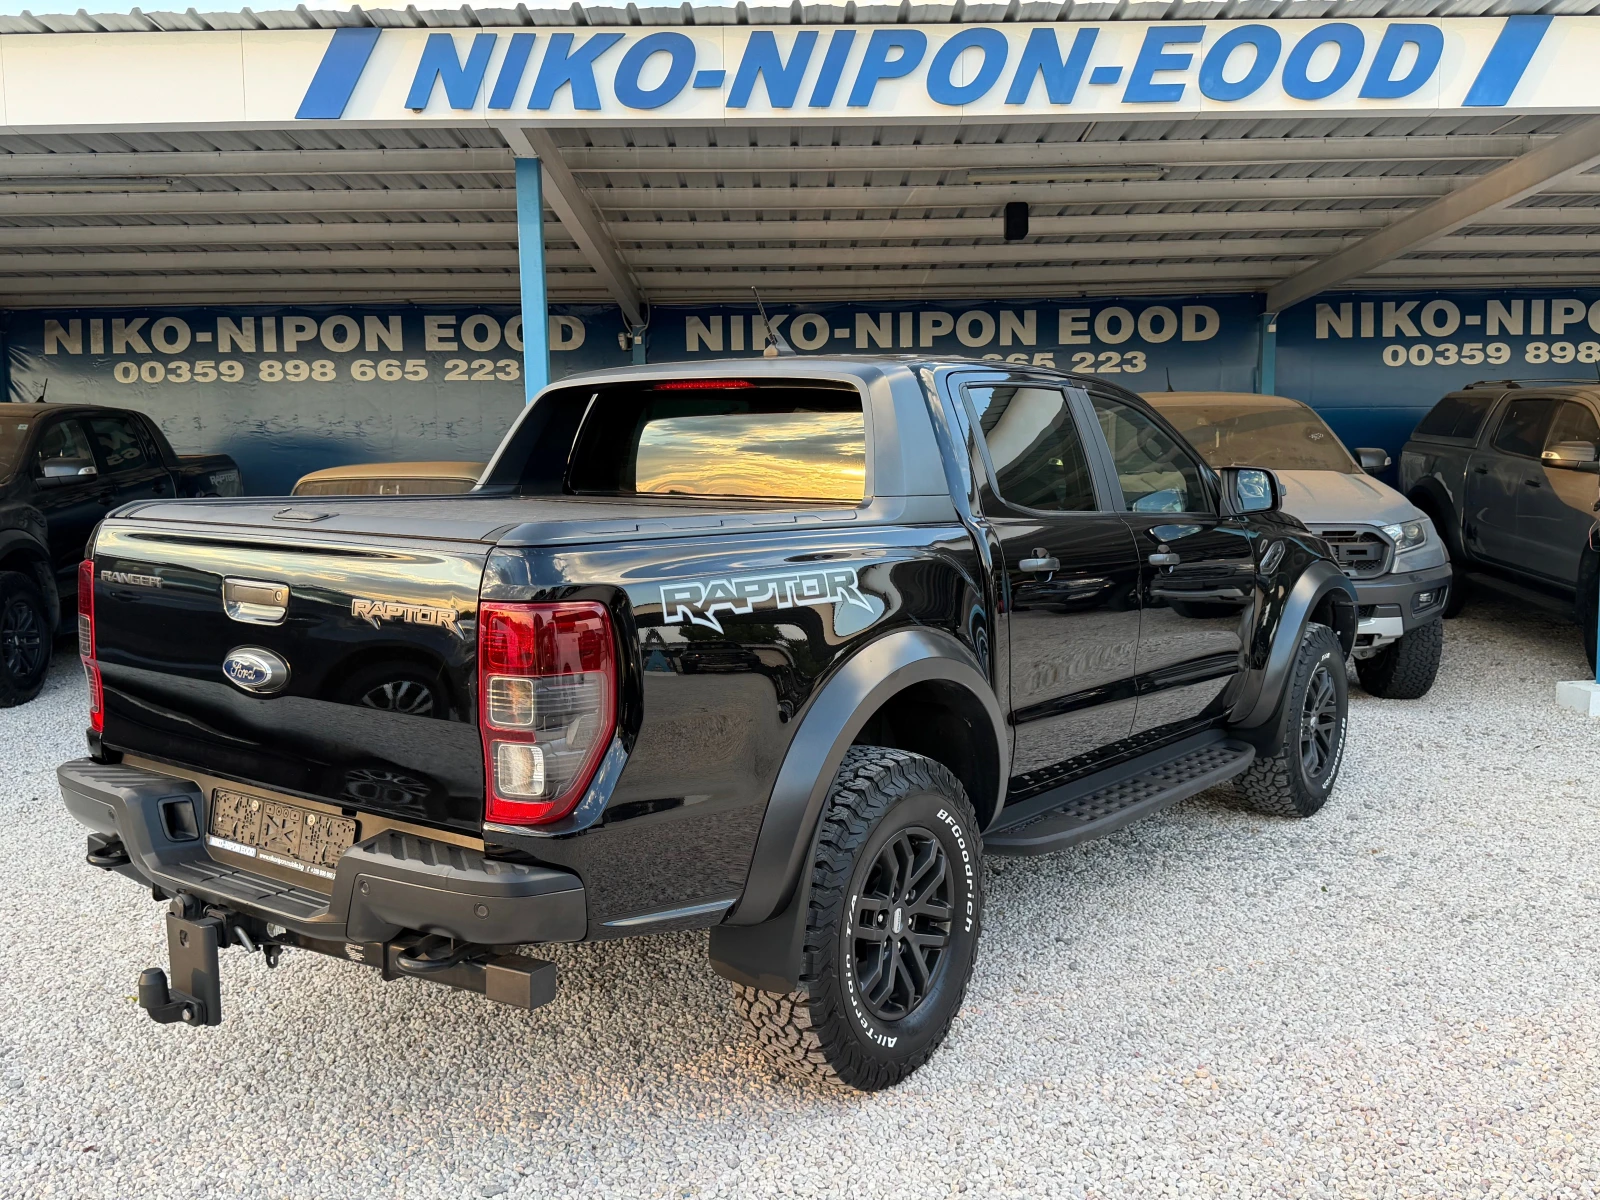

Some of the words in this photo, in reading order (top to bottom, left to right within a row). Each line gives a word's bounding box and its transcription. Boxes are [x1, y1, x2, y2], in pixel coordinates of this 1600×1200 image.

[404, 23, 1444, 110] NIKO-NIPON-EOOD
[43, 315, 404, 355] NIKO-NIPON
[685, 310, 1037, 352] NIKO-NIPON
[1057, 305, 1221, 346] EOOD
[113, 360, 245, 384] 00359
[258, 359, 337, 382] 898
[350, 359, 429, 382] 665
[444, 359, 520, 381] 223
[1071, 351, 1147, 373] 223
[1382, 342, 1511, 367] 00359
[1524, 341, 1600, 364] 898
[100, 570, 163, 588] RANGER
[351, 599, 467, 640] RAPTOR
[659, 567, 875, 635] RAPTOR
[230, 660, 257, 682] Ford
[936, 808, 973, 933] BFGoodrich
